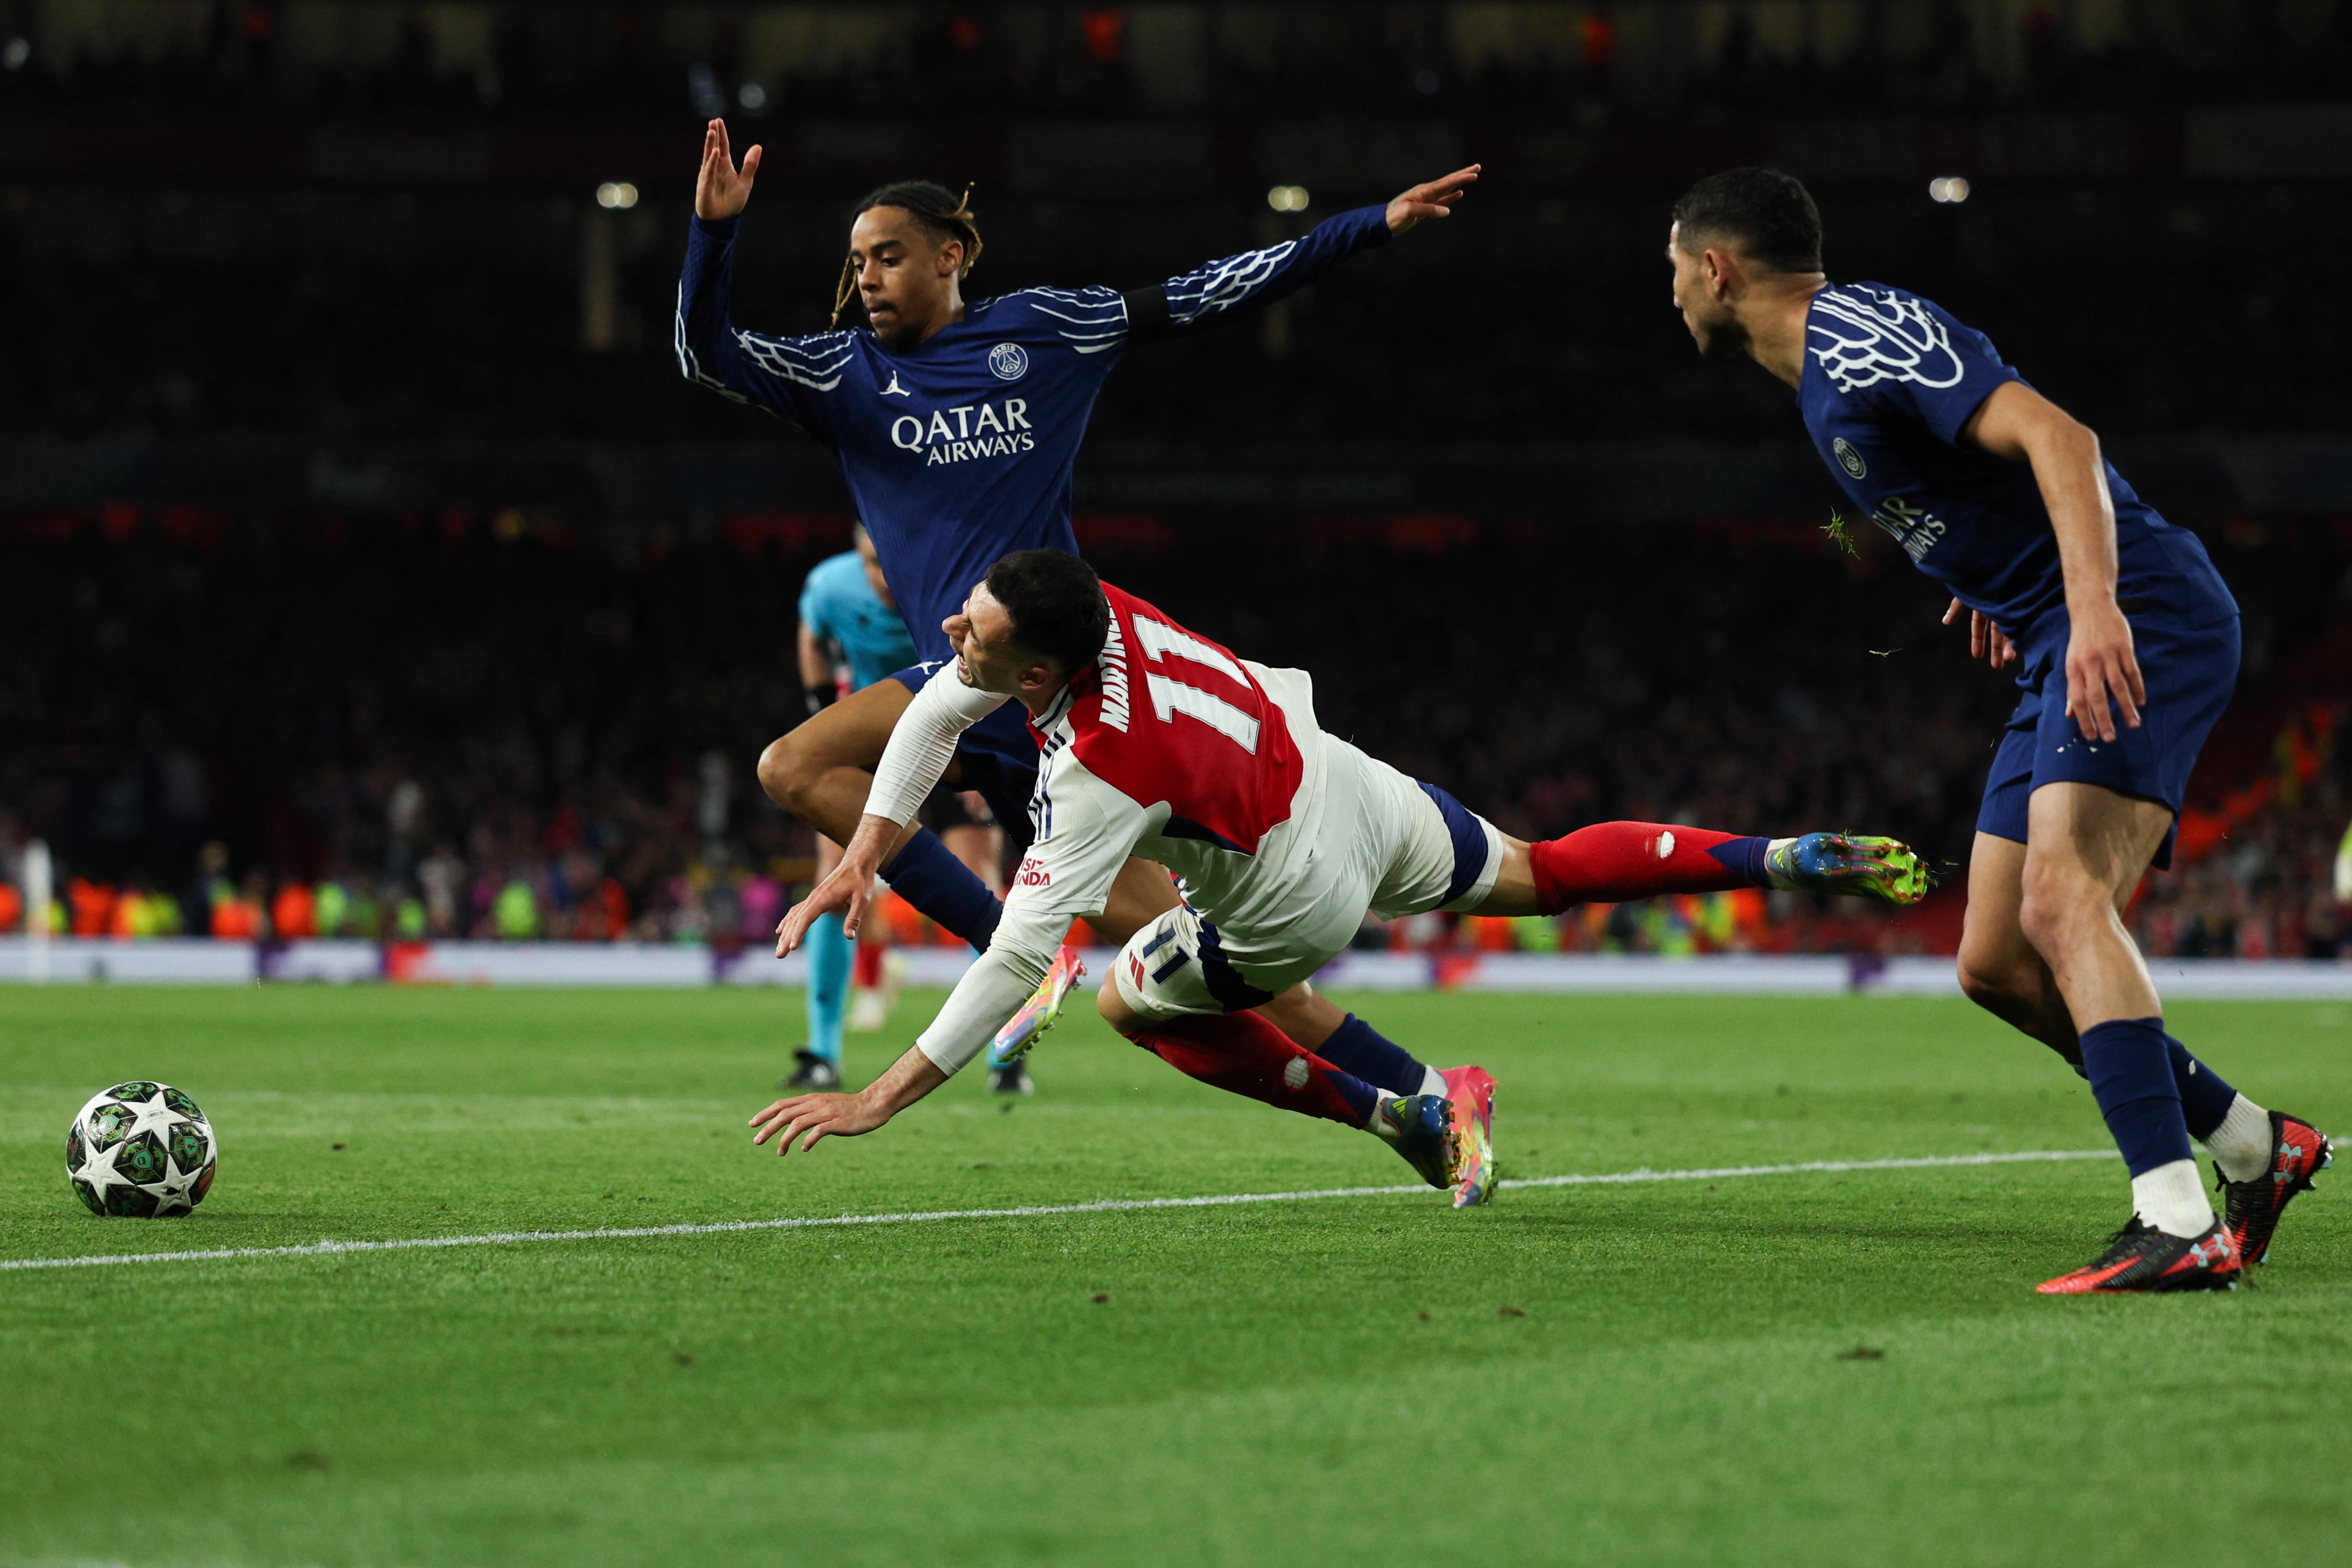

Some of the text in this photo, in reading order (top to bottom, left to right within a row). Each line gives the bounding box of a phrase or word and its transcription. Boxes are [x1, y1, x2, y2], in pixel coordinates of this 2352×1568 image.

[992, 345, 1016, 358] PARIS
[891, 398, 1033, 454] QATAR
[926, 432, 1035, 467] AIRWAYS
[1903, 513, 1946, 564] WAYS
[1098, 595, 1130, 734] MARTIN
[1132, 612, 1261, 756] 11
[1142, 921, 1193, 987] 11
